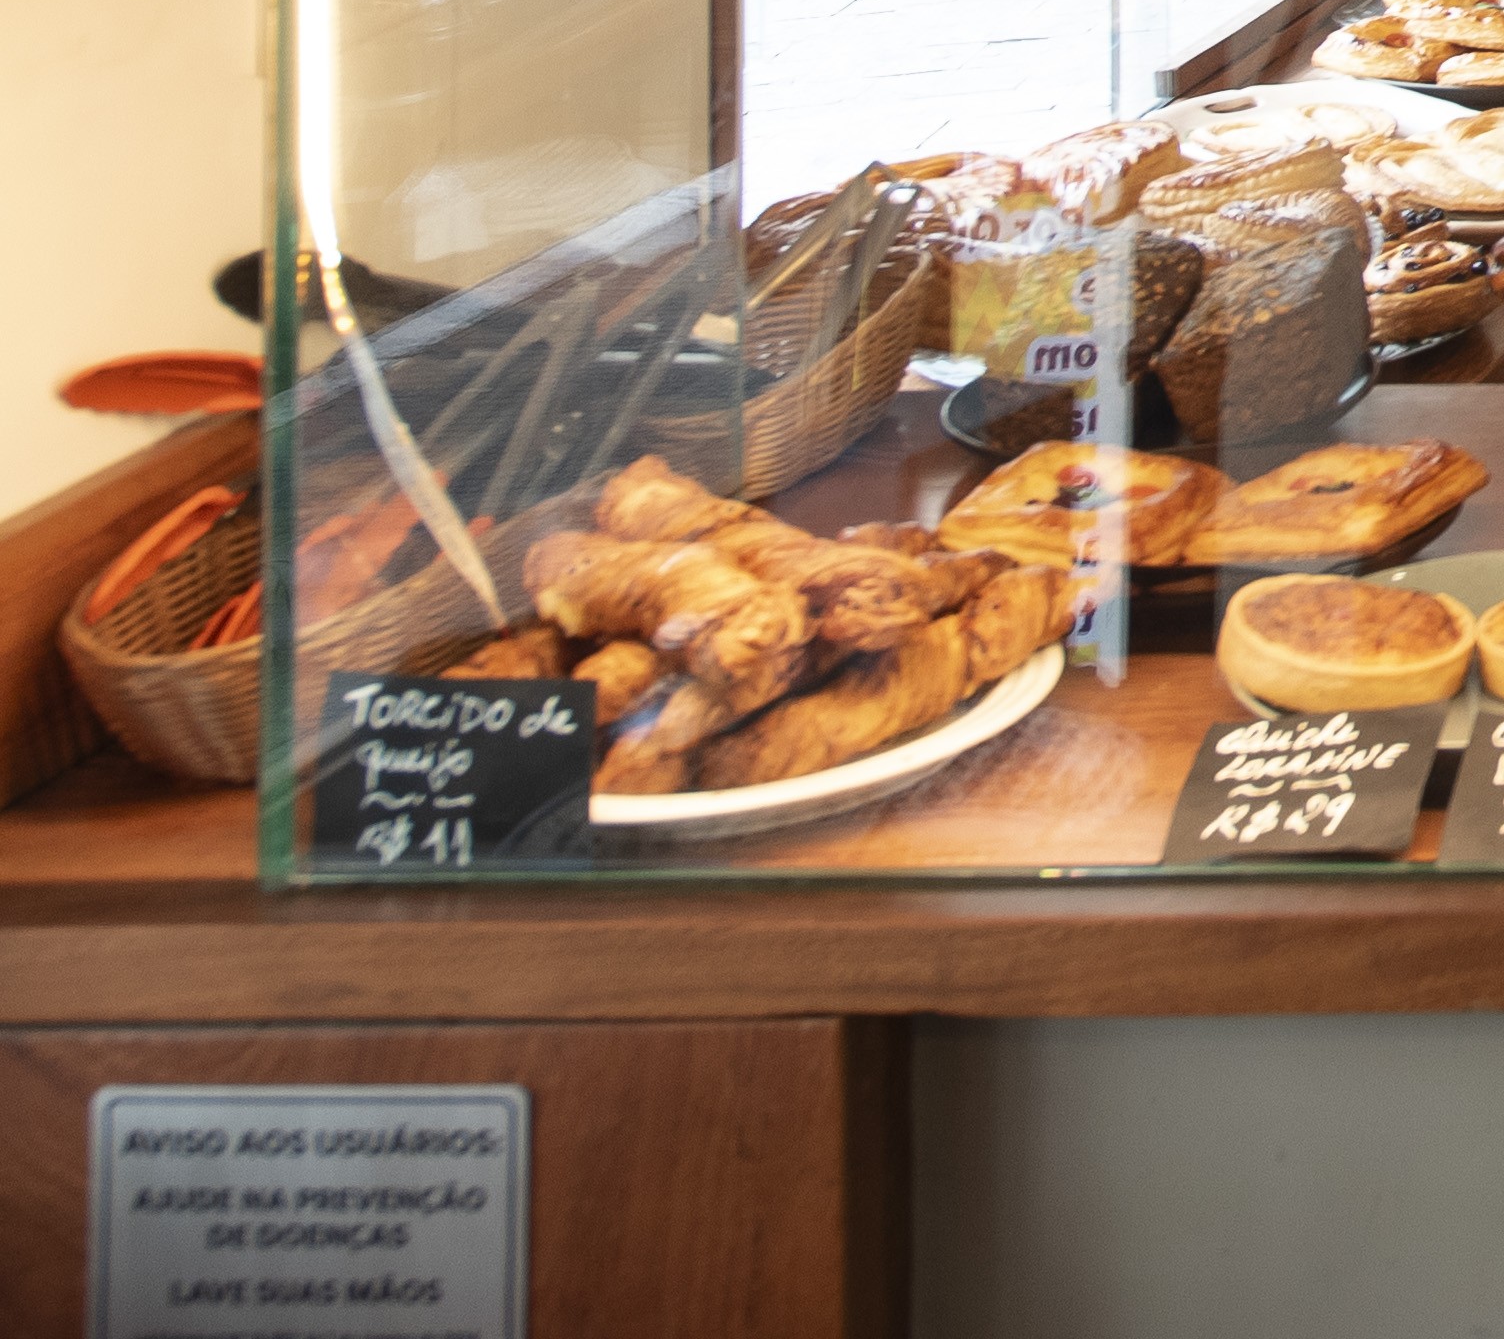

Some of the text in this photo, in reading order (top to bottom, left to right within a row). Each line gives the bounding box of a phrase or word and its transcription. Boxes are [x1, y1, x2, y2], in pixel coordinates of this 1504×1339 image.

[518, 694, 578, 739] de
[1215, 712, 1360, 755] Quiche
[355, 737, 473, 792] queijo
[355, 813, 474, 867] R$ 11
[1199, 791, 1356, 843] R$ 29
[121, 1128, 229, 1156] AVISO
[236, 1128, 307, 1157] AOS
